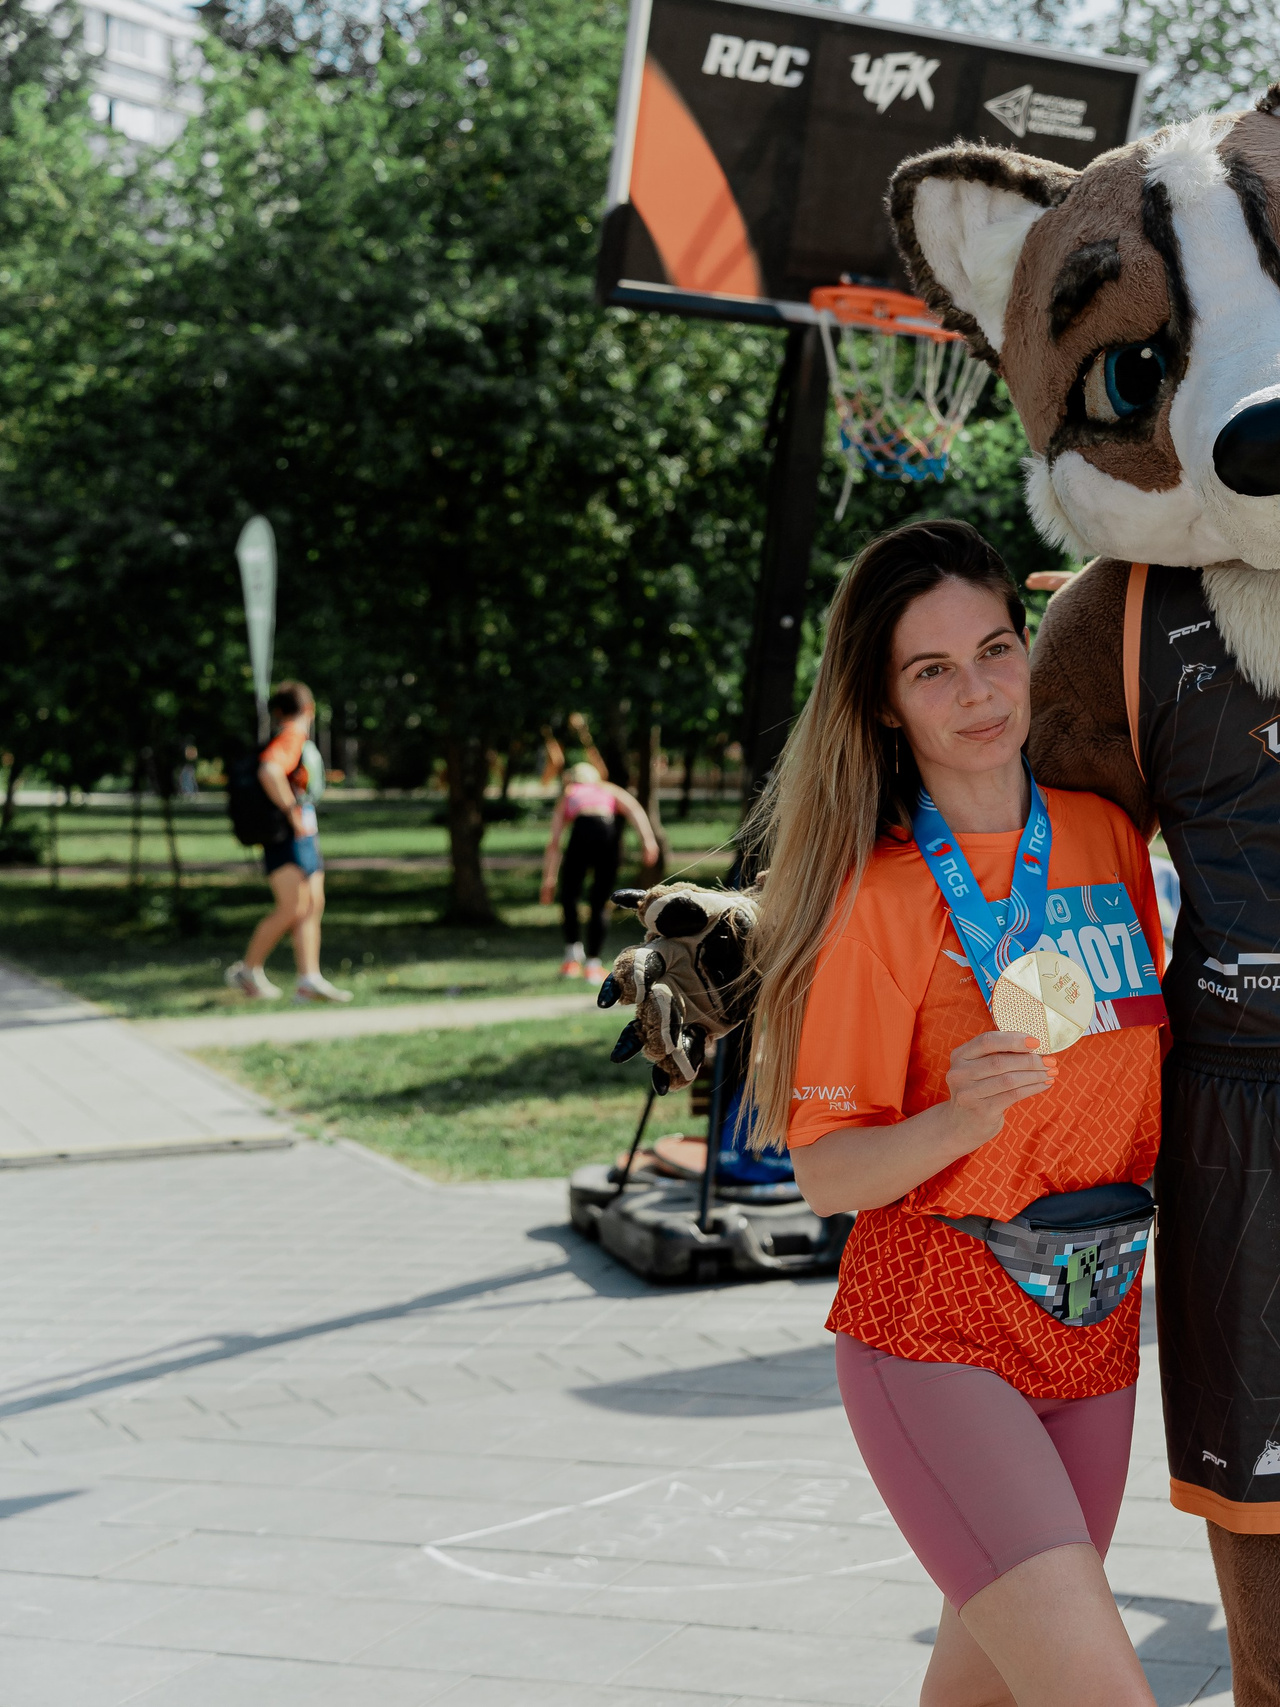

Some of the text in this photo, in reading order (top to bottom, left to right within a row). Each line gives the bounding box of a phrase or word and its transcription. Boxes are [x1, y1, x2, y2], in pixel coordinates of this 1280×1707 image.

[701, 33, 810, 88] RCC
[1028, 813, 1047, 854] ПСБ
[939, 858, 970, 898] ПСБ
[1197, 977, 1239, 1003] ФОНД
[829, 1100, 857, 1111] RUN
